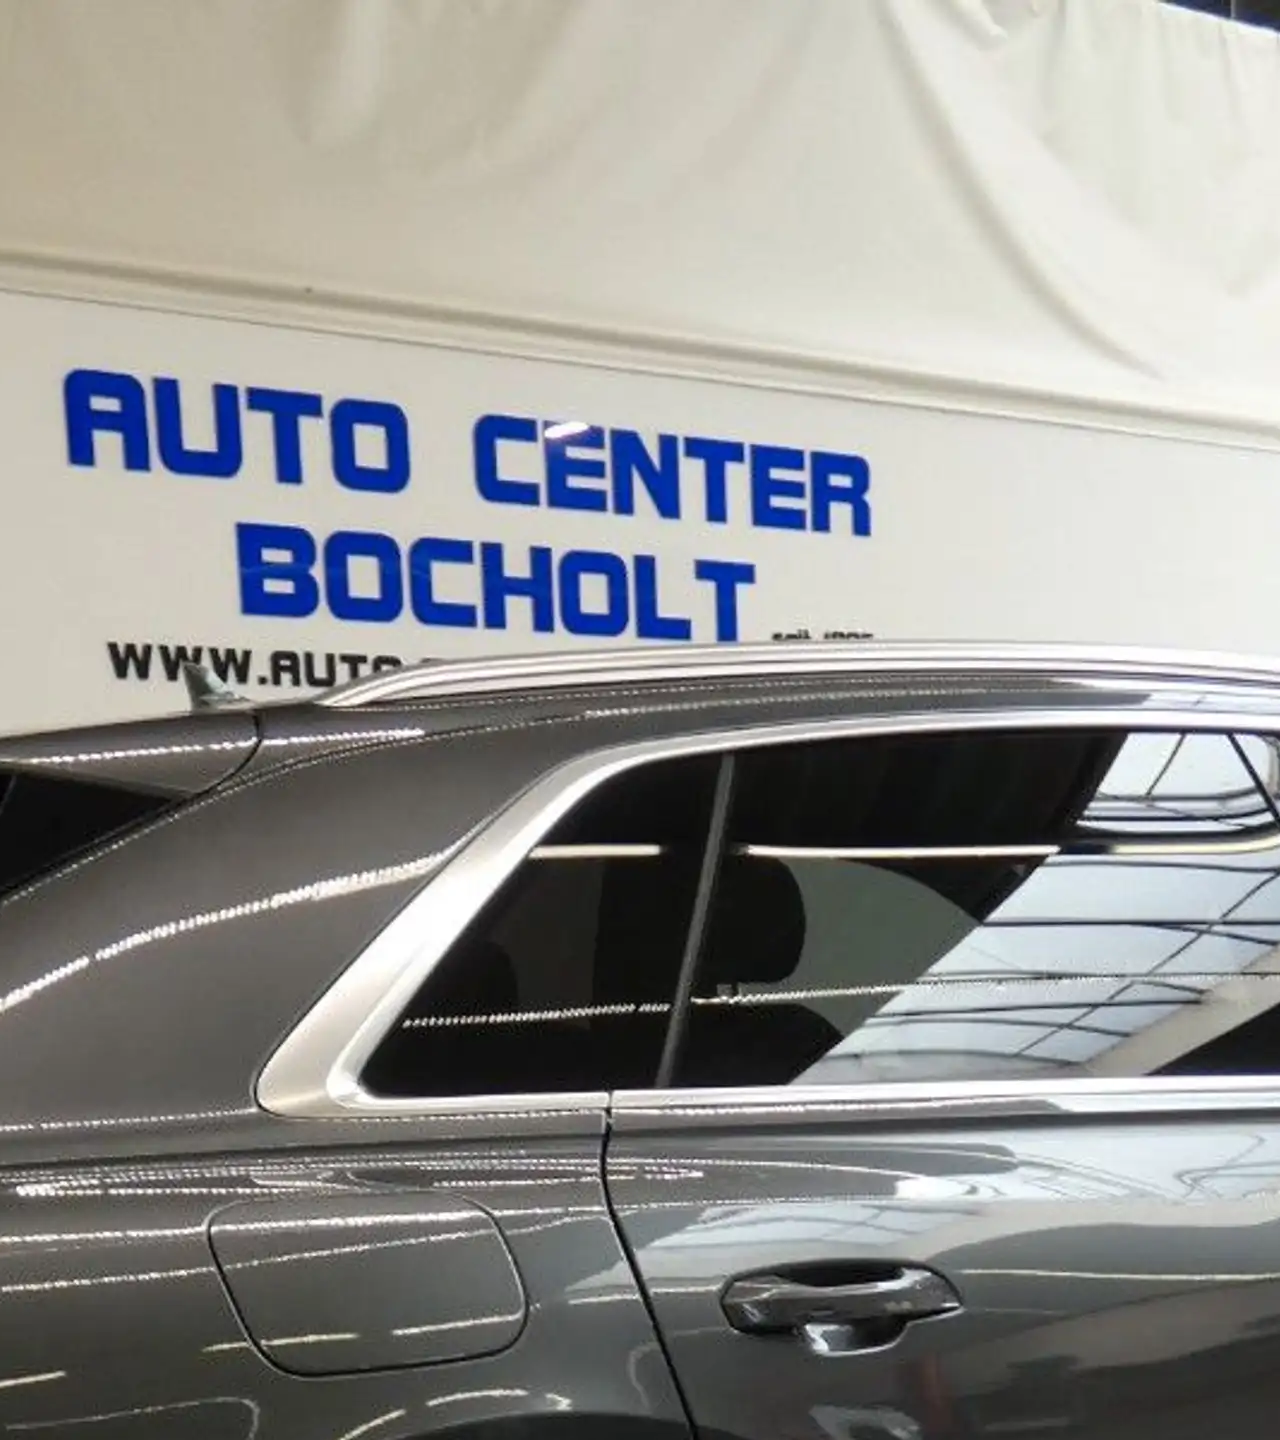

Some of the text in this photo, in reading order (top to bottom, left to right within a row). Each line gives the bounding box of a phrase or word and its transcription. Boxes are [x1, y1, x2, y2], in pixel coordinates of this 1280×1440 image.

[64, 368, 872, 537] AUTO CENTER
[236, 523, 756, 643] BOCHOLT
